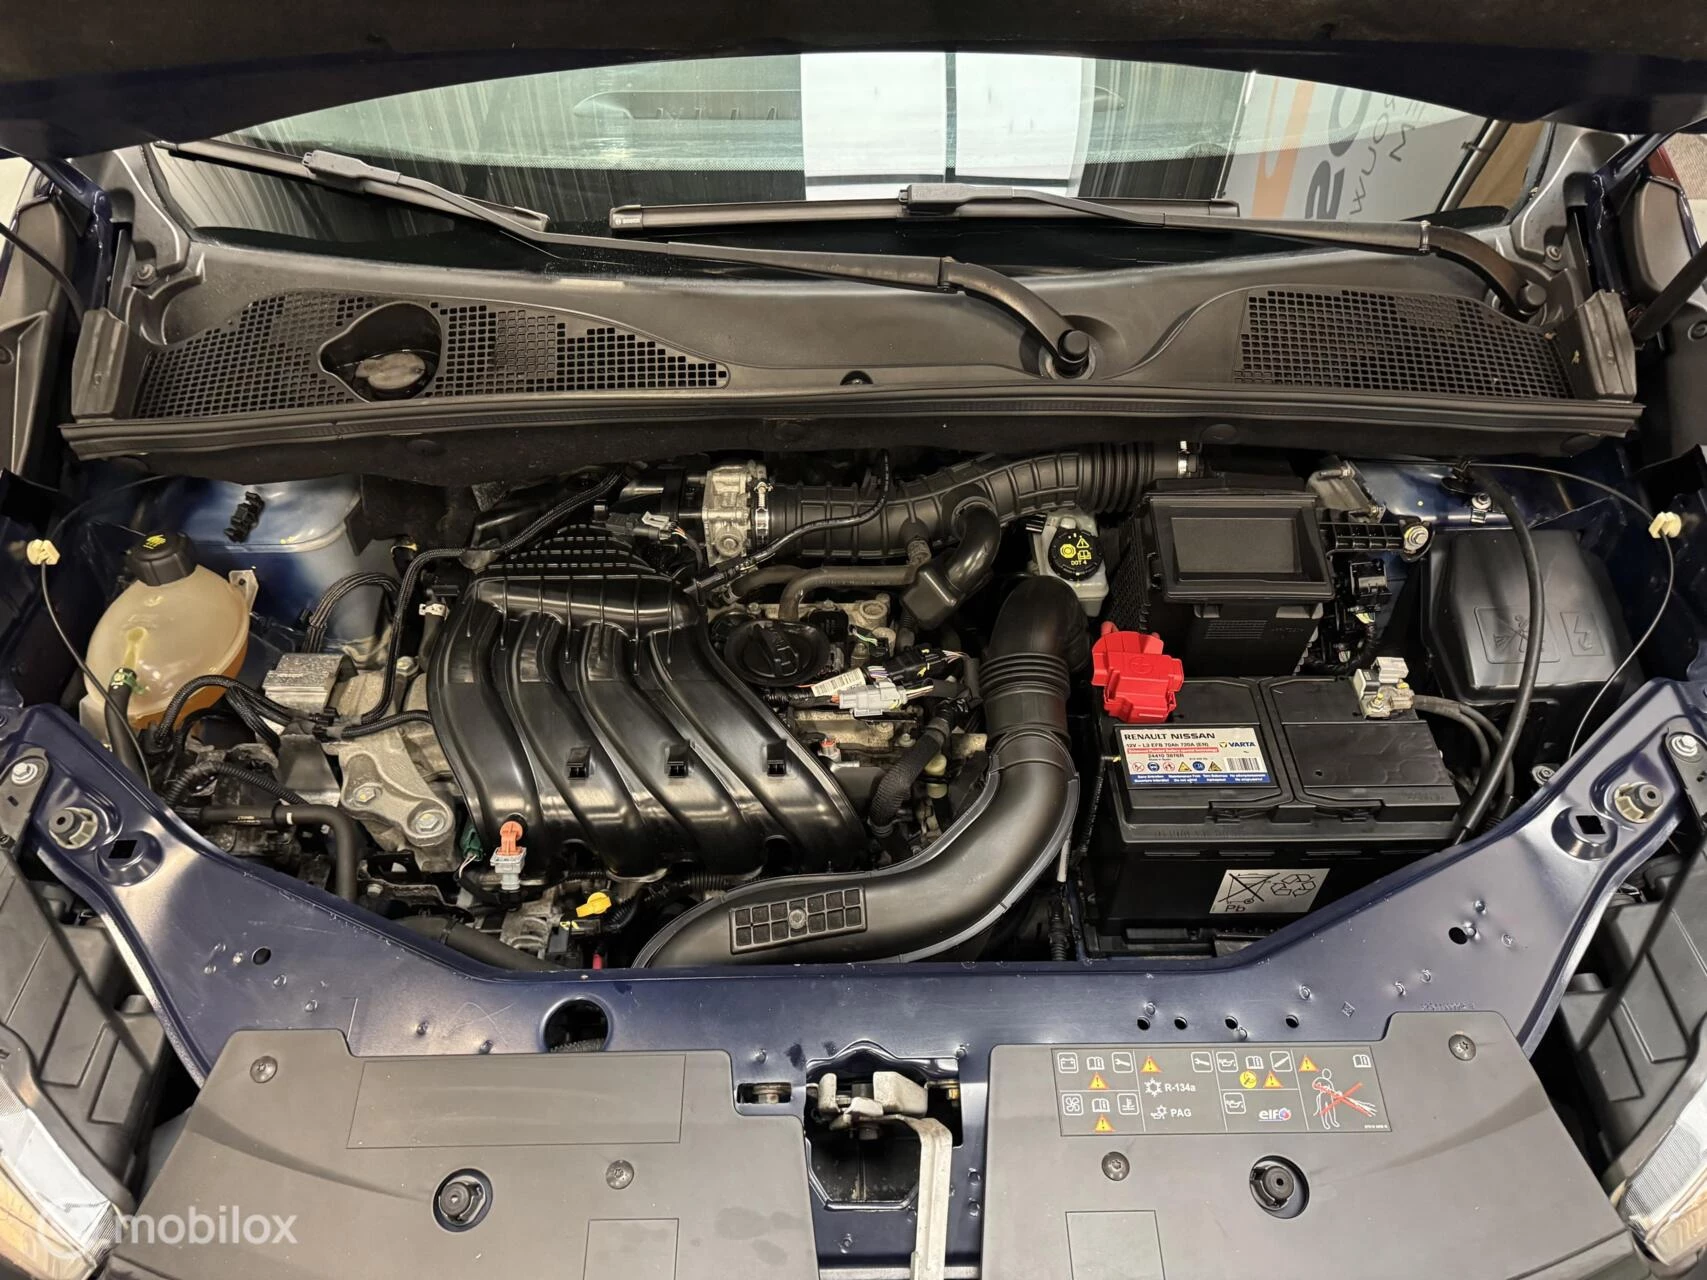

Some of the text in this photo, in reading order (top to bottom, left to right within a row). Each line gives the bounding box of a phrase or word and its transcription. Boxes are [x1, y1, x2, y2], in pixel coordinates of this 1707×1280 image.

[1124, 732, 1215, 741] RENAULT NISSAN
[1225, 904, 1246, 913] Pb
[1164, 1083, 1196, 1092] R-134a
[1170, 1108, 1192, 1117] PAG
